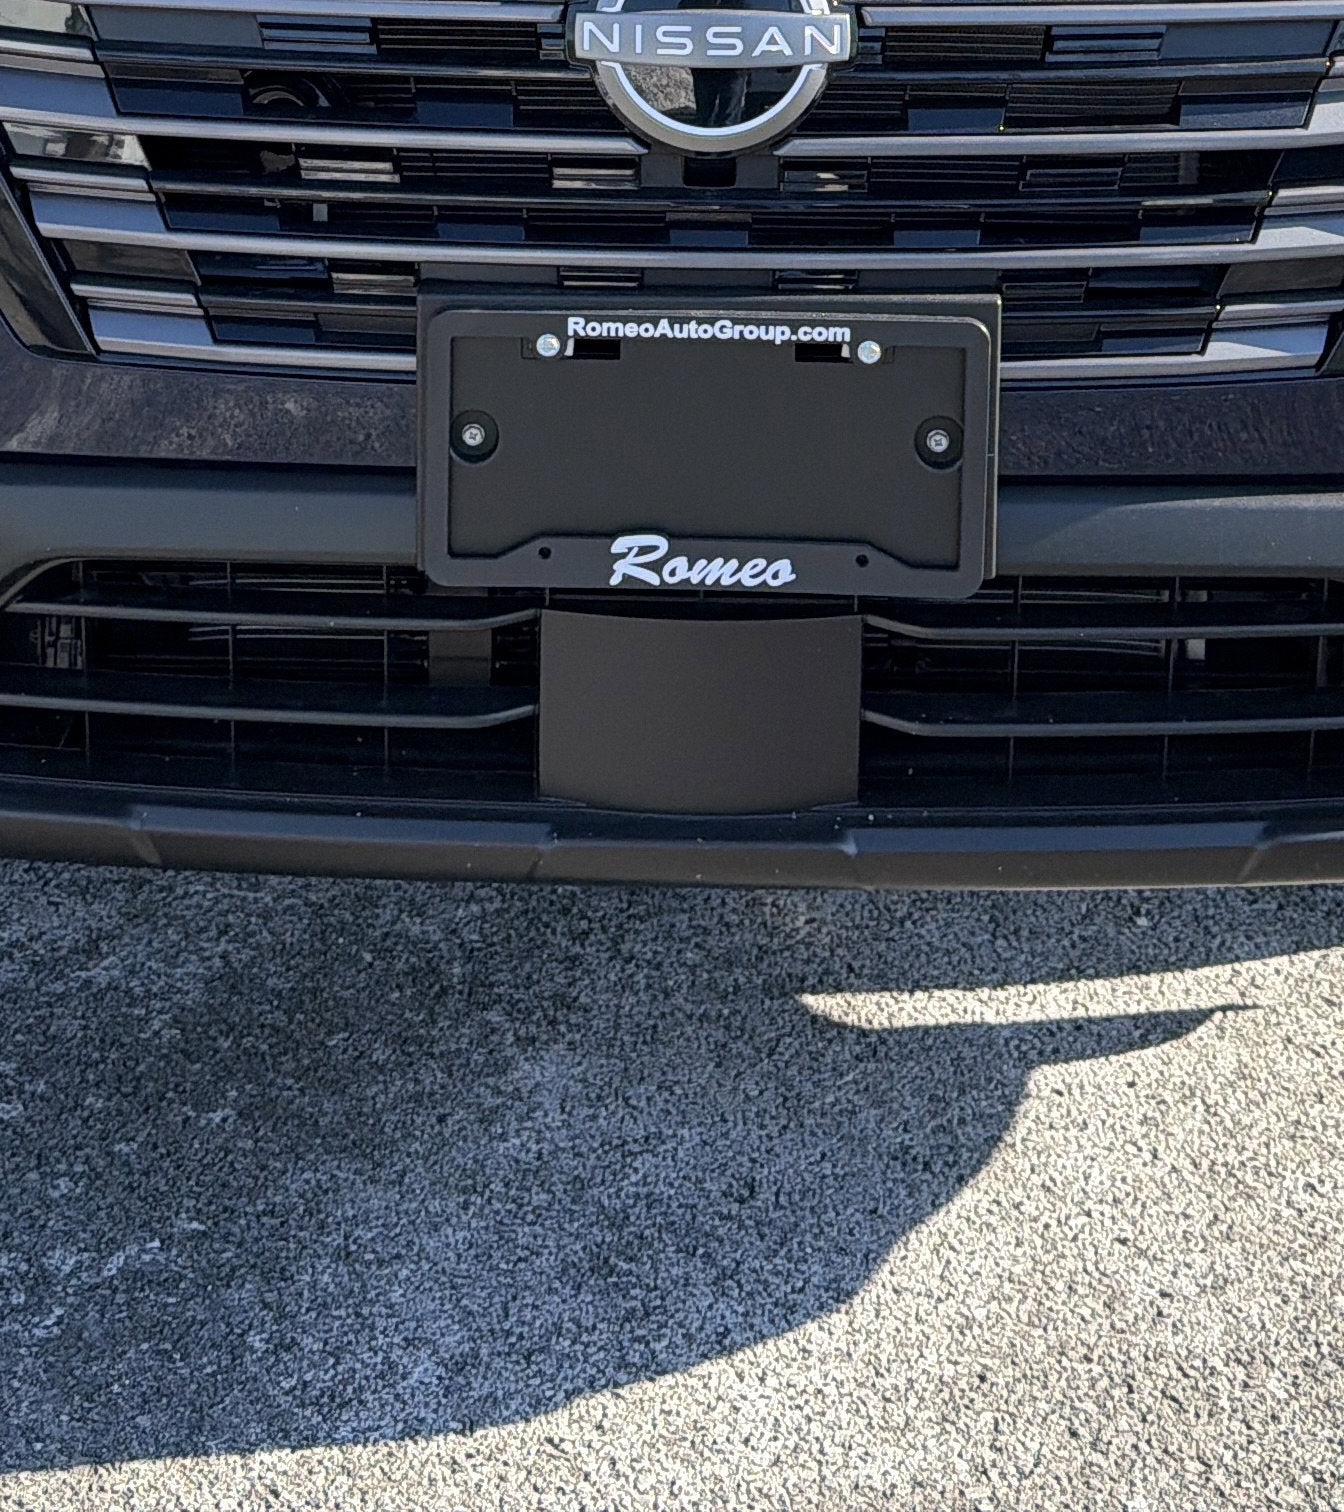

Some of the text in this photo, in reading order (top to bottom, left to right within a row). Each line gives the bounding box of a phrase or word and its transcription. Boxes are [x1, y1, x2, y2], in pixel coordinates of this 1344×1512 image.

[583, 21, 841, 57] NISSAN
[567, 317, 851, 345] RomeoAutoGroup.com
[608, 534, 797, 586] Romeo
